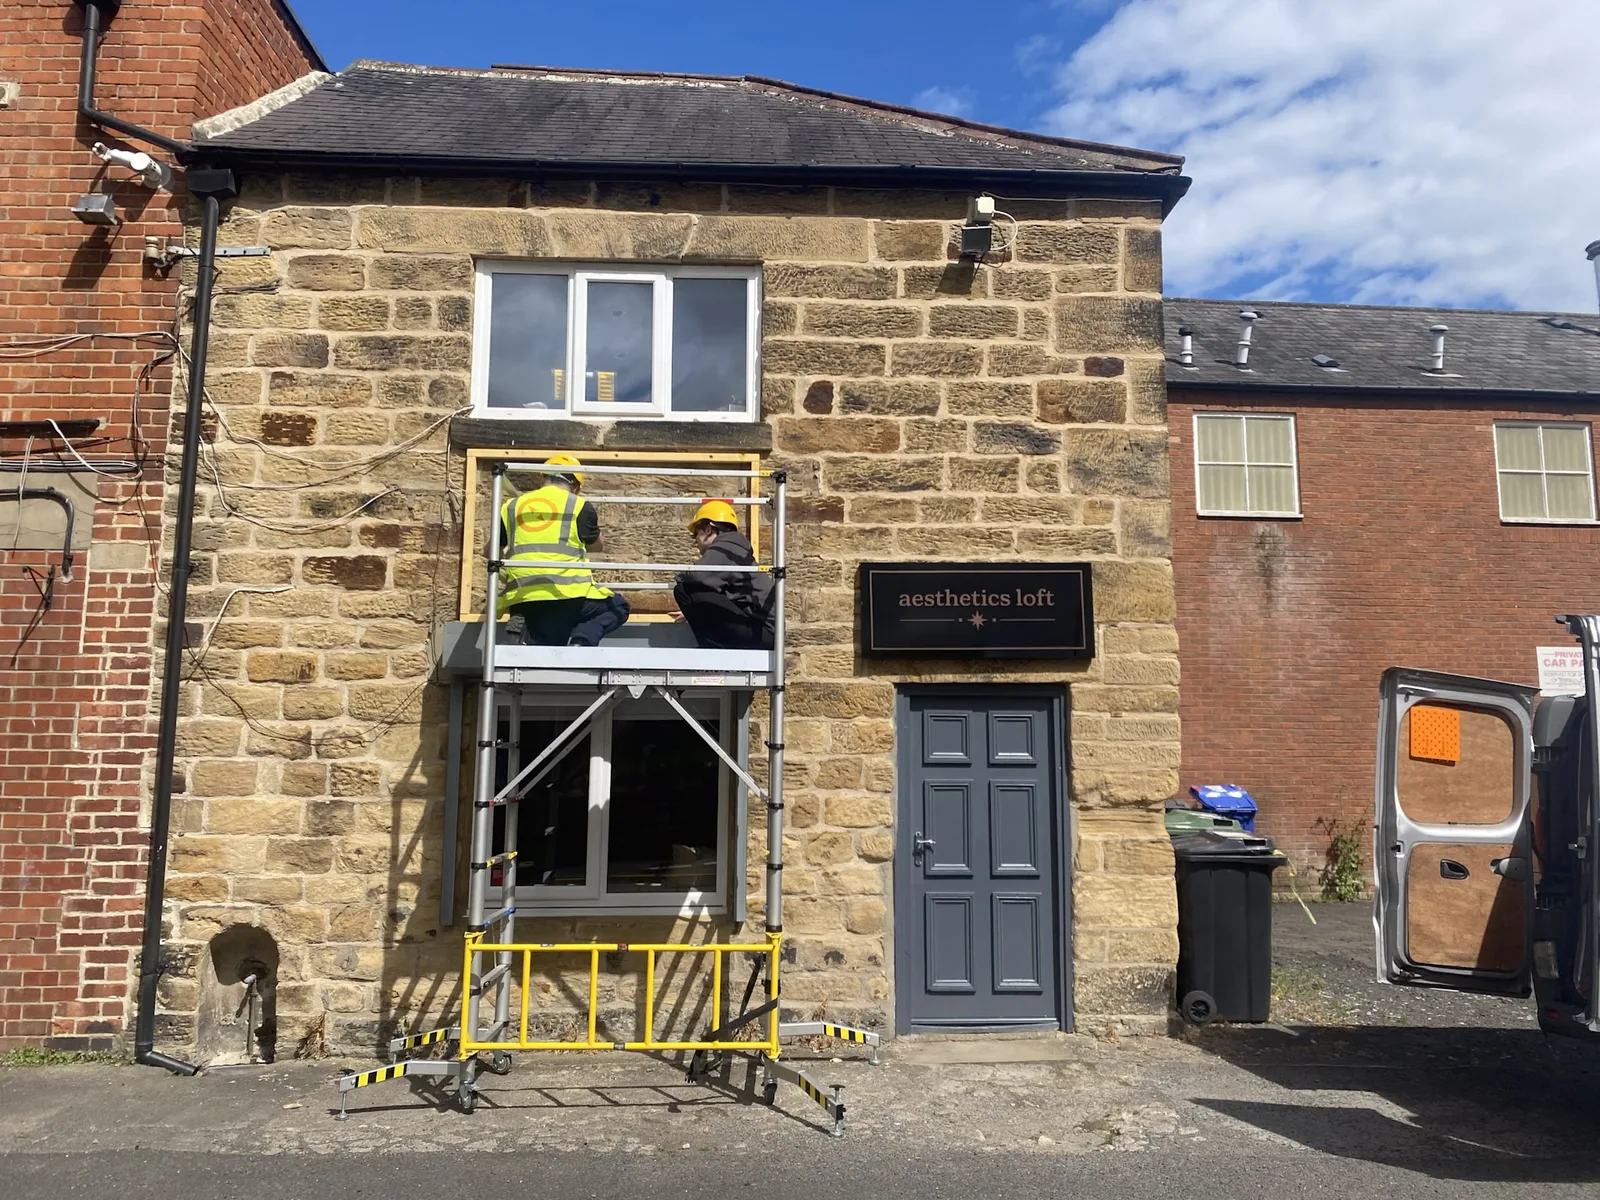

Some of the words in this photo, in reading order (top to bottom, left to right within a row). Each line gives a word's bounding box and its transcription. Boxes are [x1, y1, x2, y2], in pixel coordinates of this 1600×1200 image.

[899, 589, 1011, 607] aesthetics
[1016, 588, 1055, 607] loft
[1543, 659, 1567, 667] CAR
[1571, 659, 1584, 667] PA
